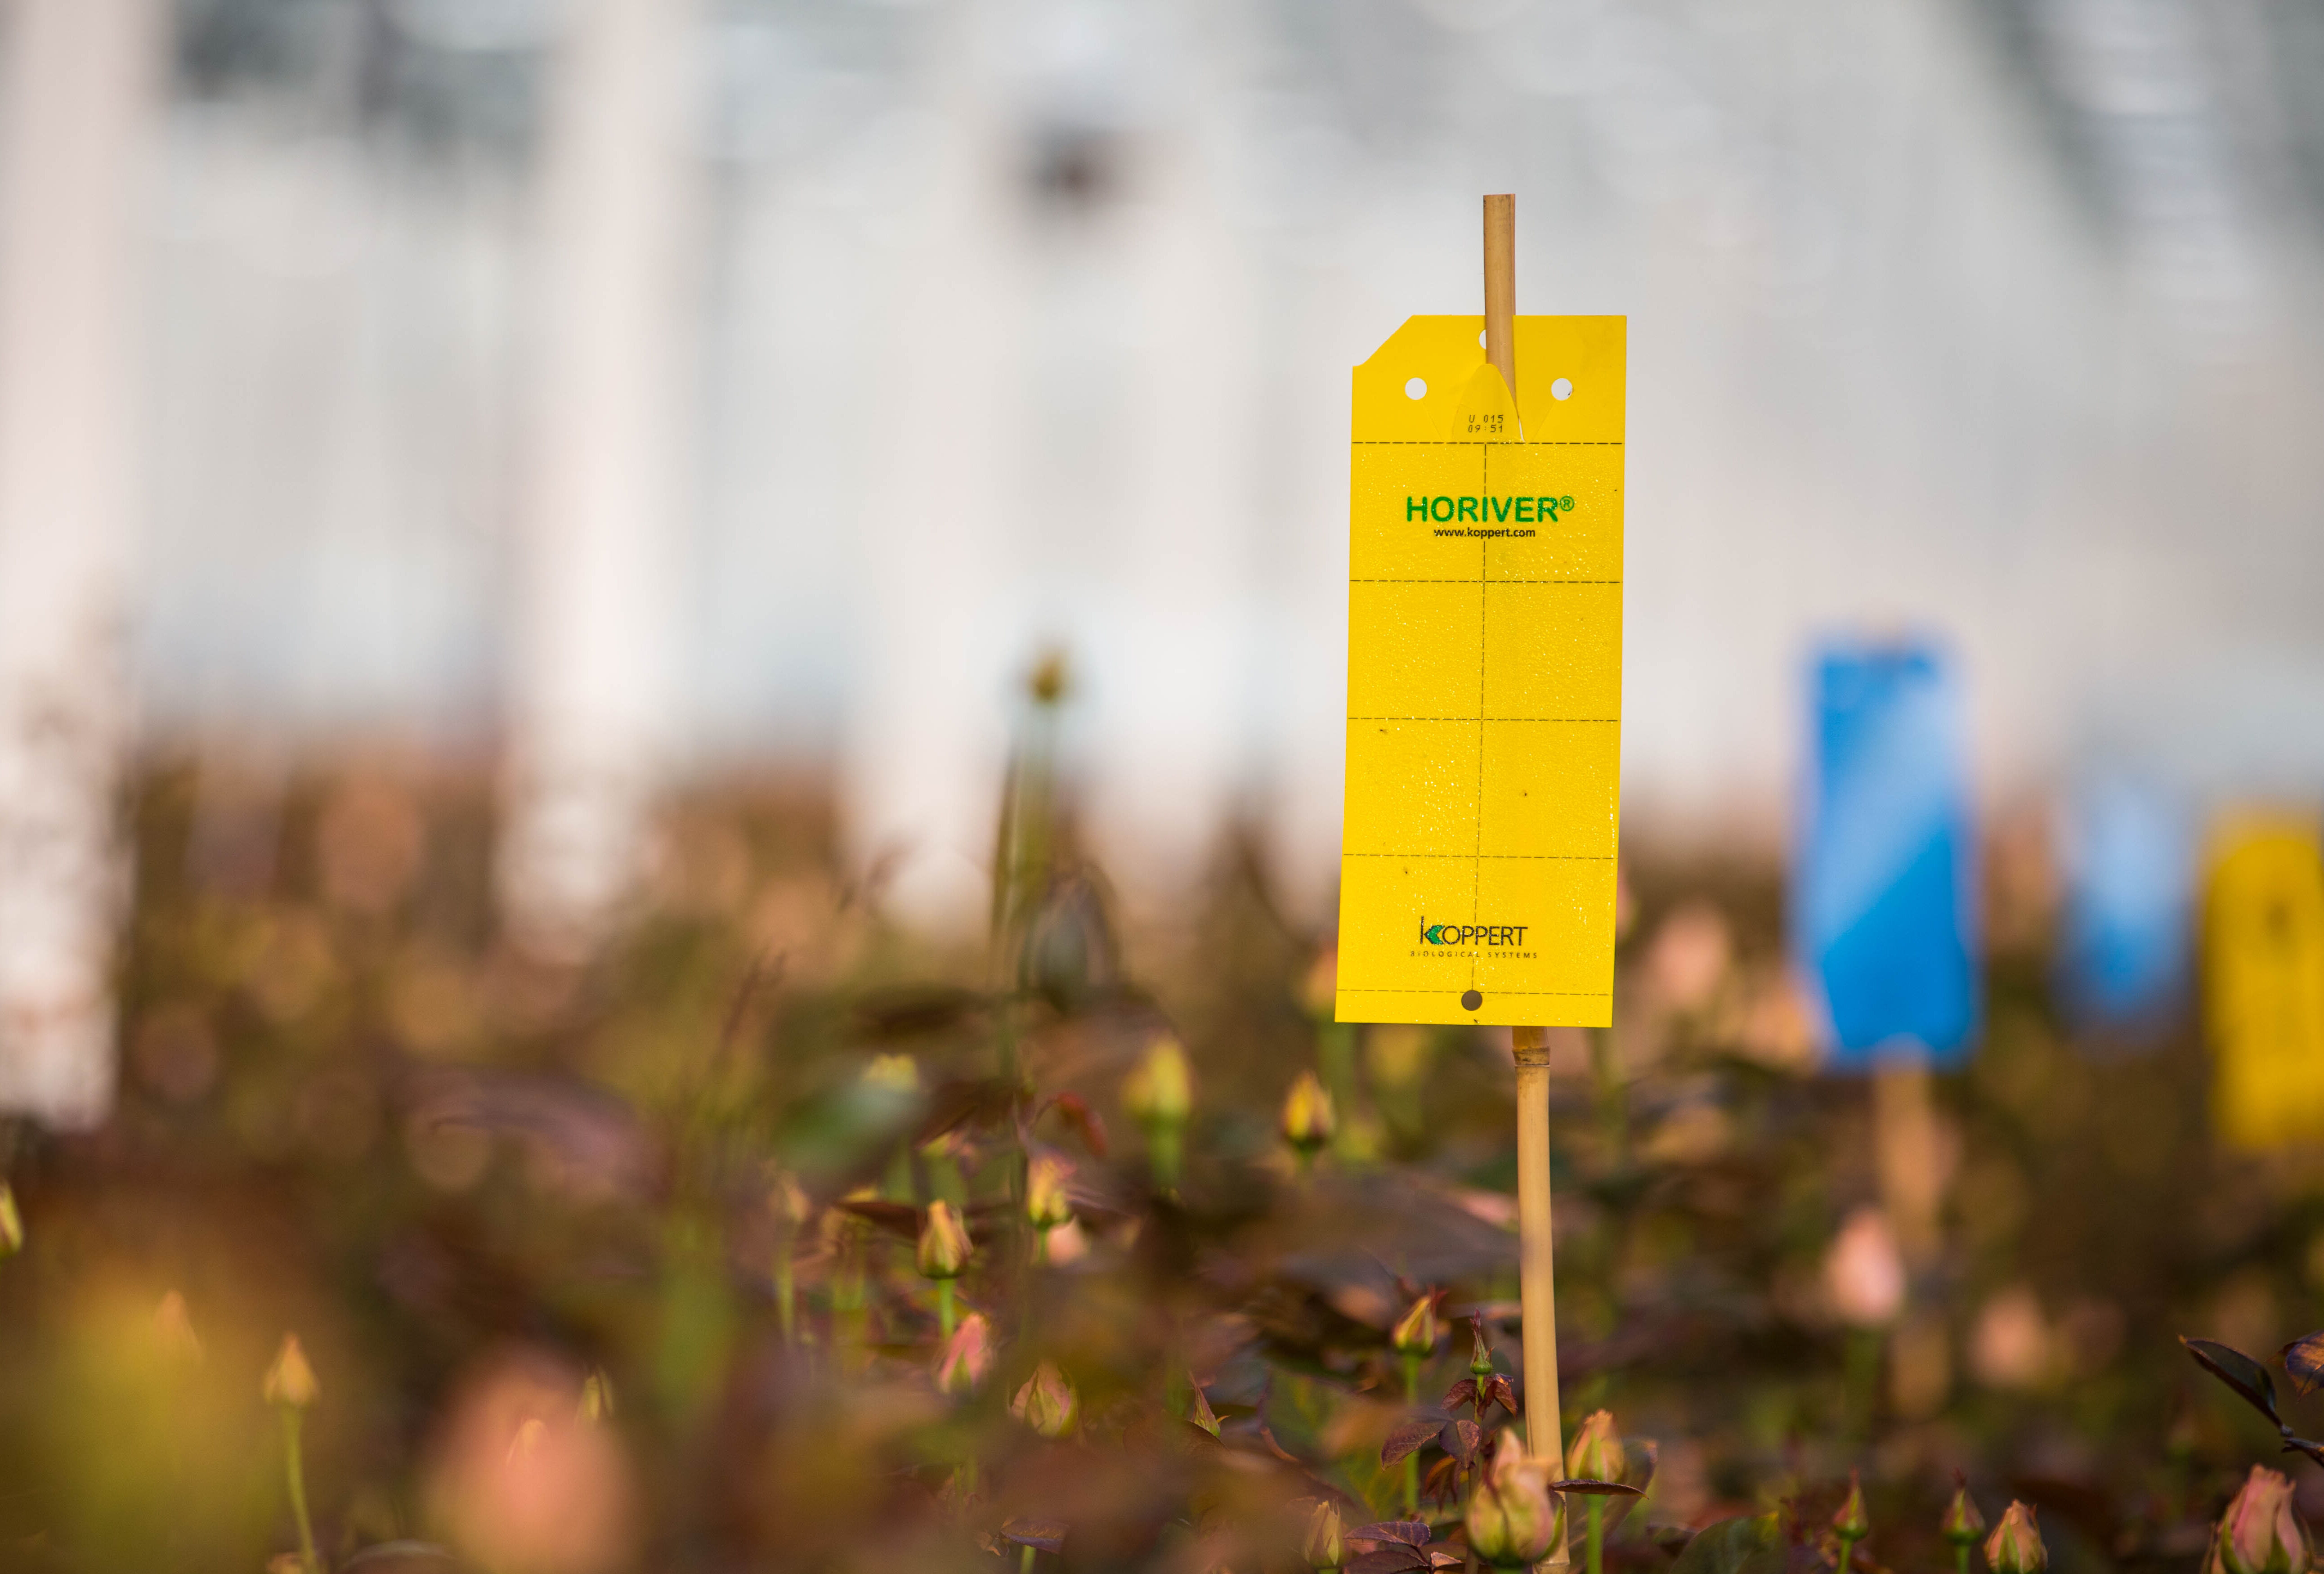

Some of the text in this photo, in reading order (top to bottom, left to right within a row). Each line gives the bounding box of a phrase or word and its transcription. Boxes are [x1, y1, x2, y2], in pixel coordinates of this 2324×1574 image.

[1469, 414, 1504, 423] U 015
[1468, 424, 1503, 433] 09:51
[1434, 527, 1536, 539] www.koppert.com
